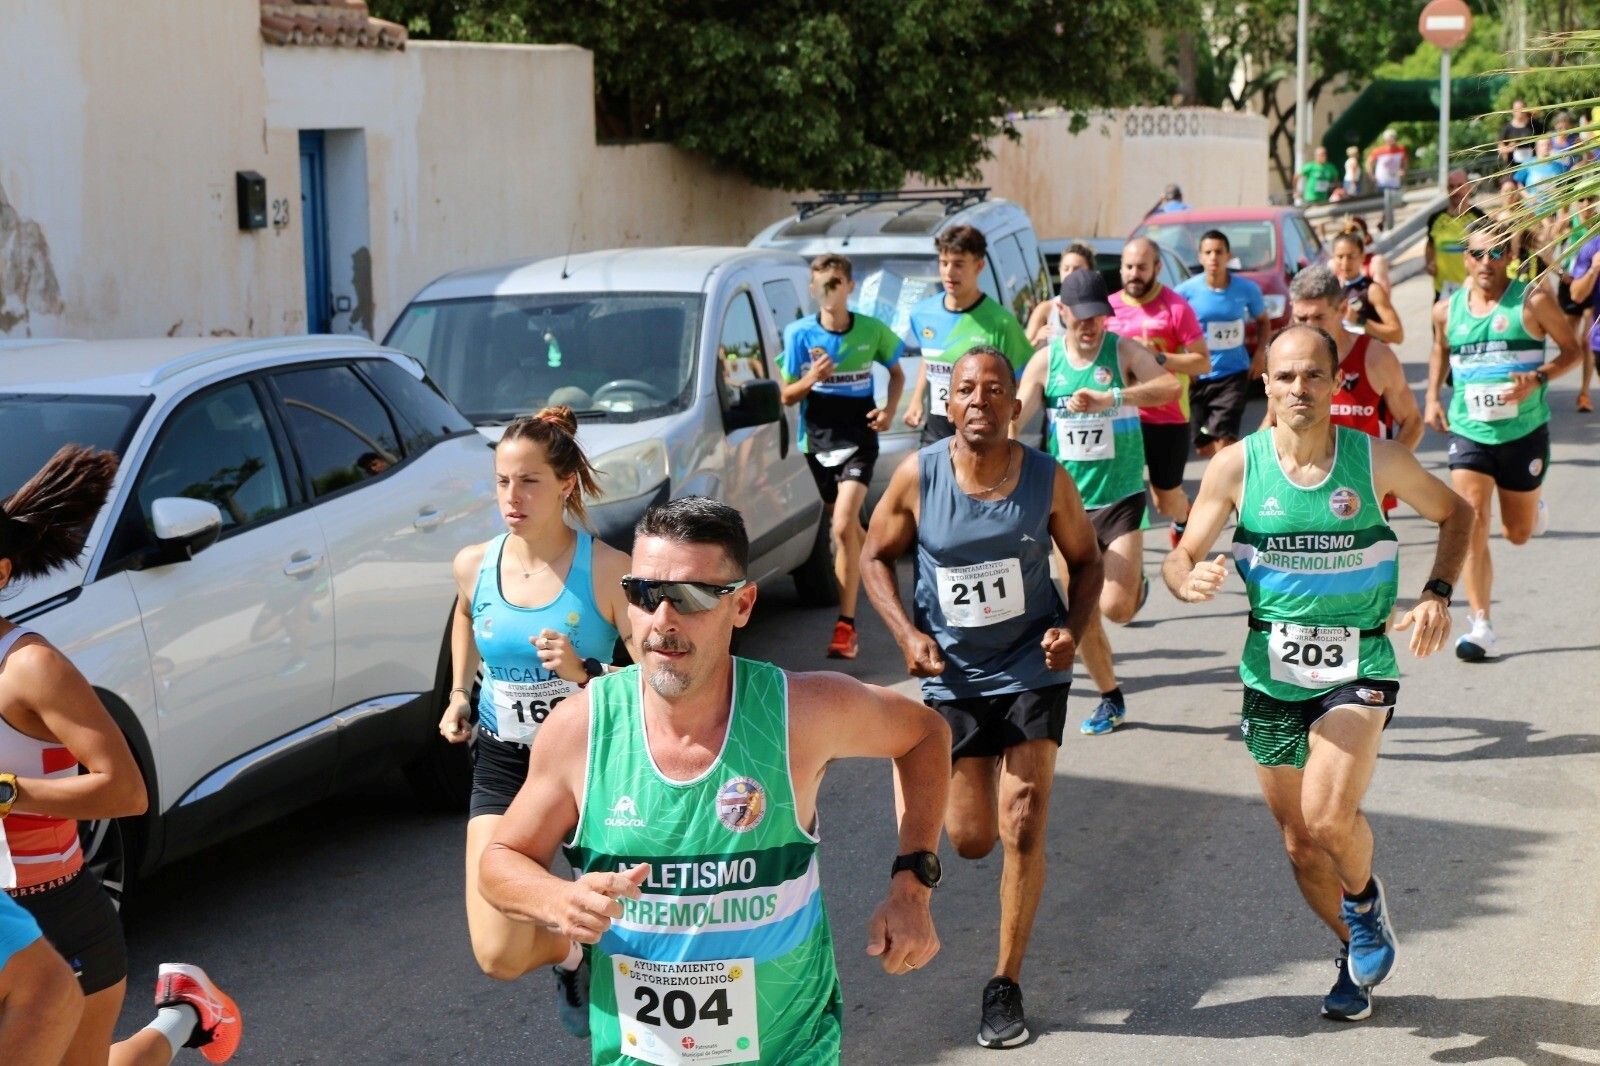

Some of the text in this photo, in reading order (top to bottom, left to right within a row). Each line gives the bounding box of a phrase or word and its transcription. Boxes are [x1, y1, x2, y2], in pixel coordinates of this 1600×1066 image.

[272, 199, 290, 225] 23
[1330, 404, 1375, 416] EDRO
[1066, 429, 1103, 445] 177
[1266, 534, 1355, 551] ATLETISMO
[951, 577, 1007, 606] 211
[1281, 641, 1344, 668] 203
[614, 892, 778, 928] RREMOLINOS
[634, 959, 725, 974] AYUNTAMIENTO
[634, 985, 733, 1030] 204
